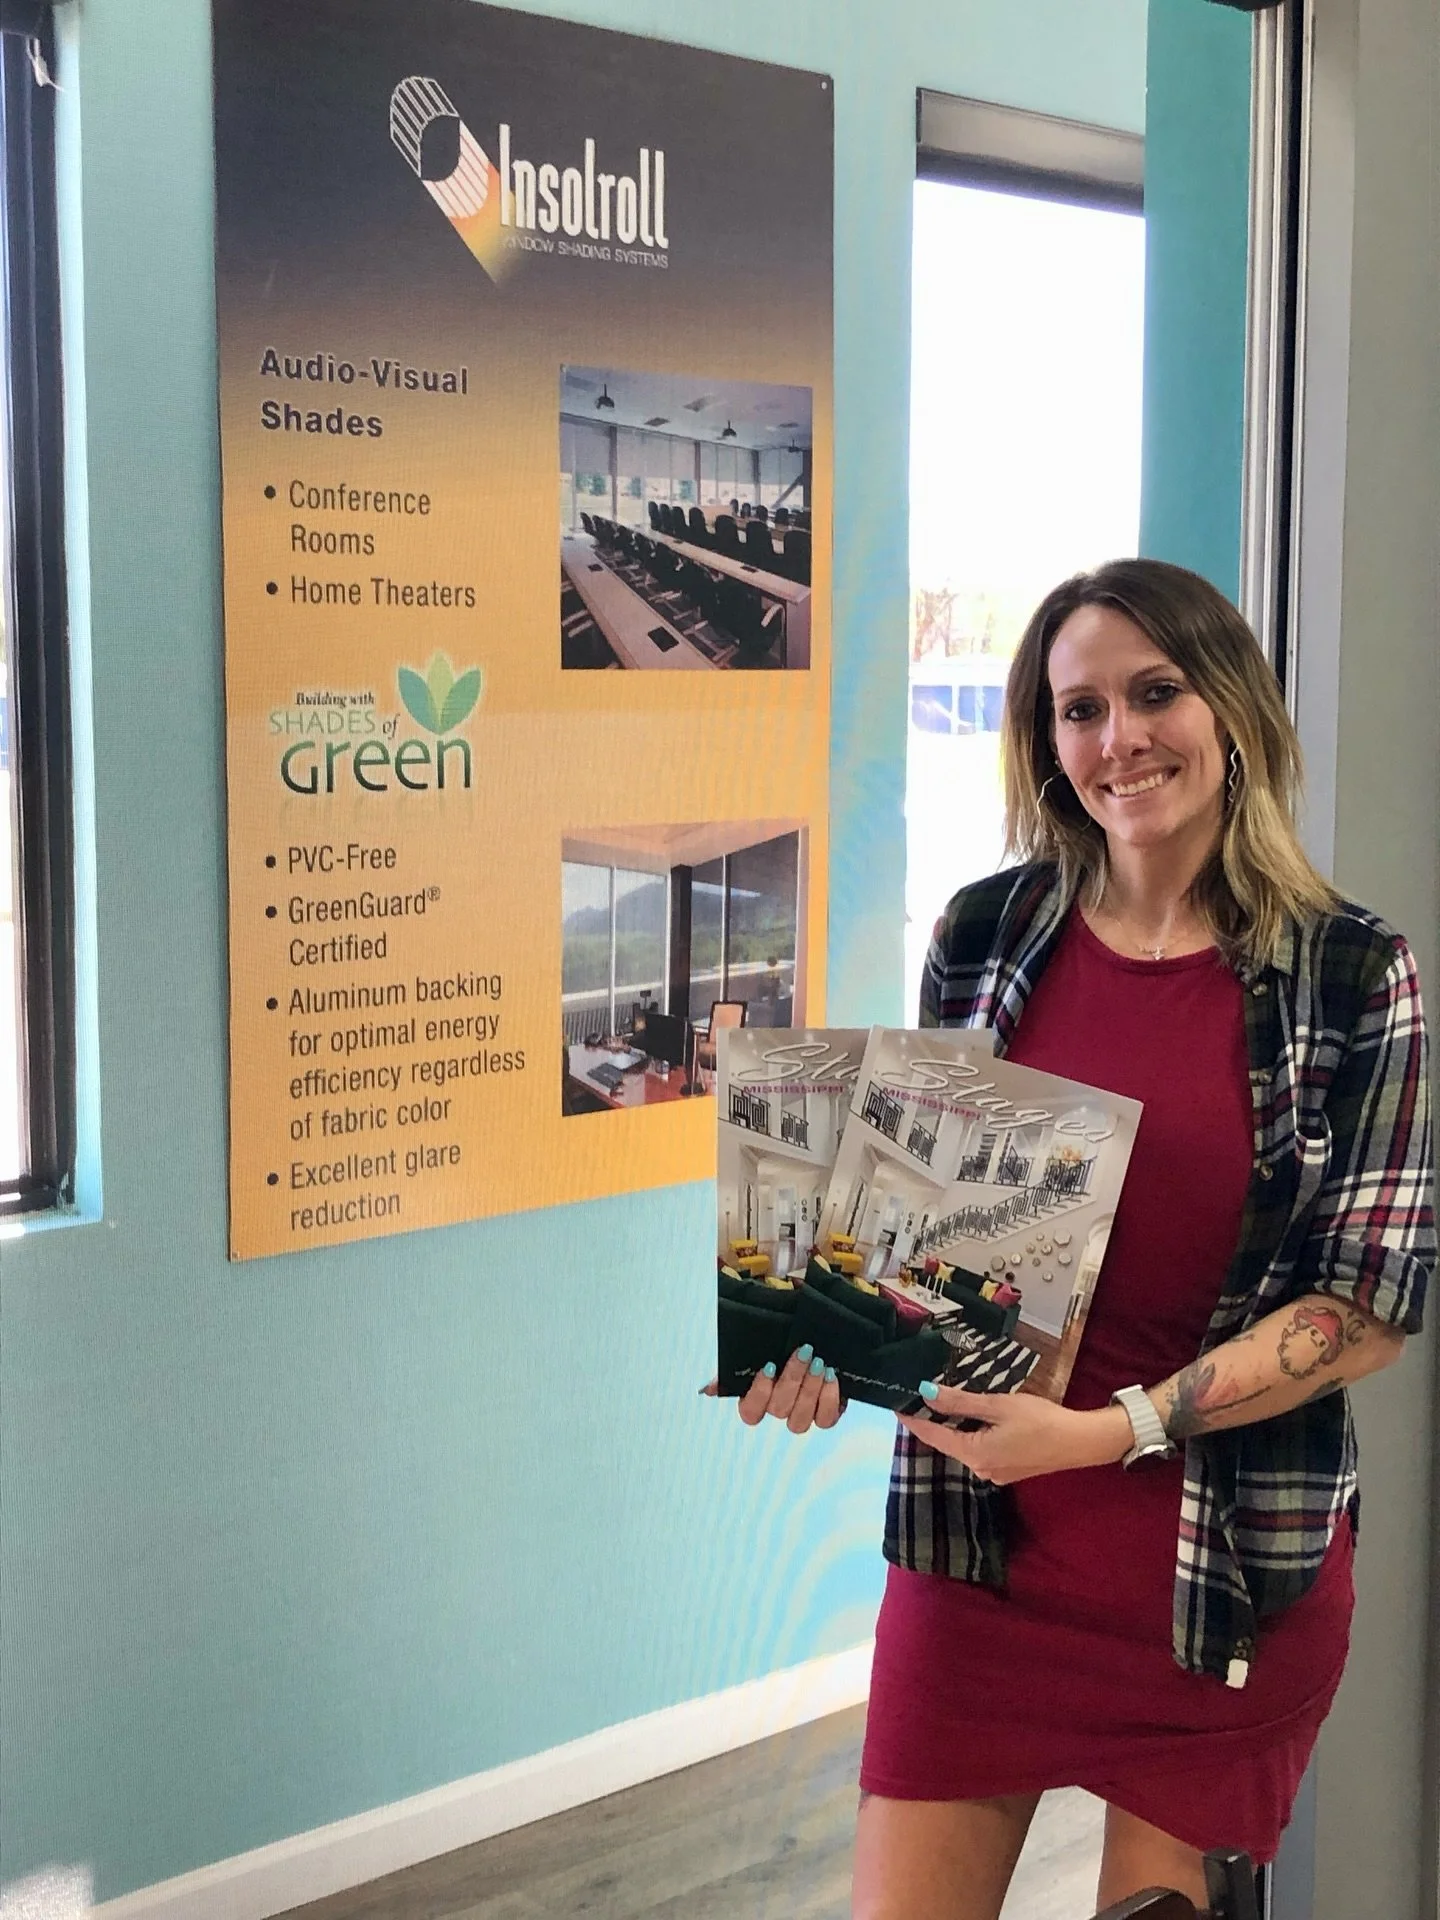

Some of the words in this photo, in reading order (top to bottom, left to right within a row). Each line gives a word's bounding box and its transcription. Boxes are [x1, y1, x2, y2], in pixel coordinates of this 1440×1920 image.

[500, 124, 668, 249] Insolroll
[558, 240, 611, 261] SHADING
[614, 248, 669, 268] SYSTEMS
[260, 348, 468, 395] Audio-Visual
[260, 400, 384, 438] Shades
[289, 479, 432, 515] Conference
[290, 523, 375, 556] Rooms
[290, 574, 362, 605] Home
[370, 576, 476, 608] Theaters
[295, 691, 347, 709] Building
[349, 691, 375, 705] with
[268, 709, 376, 735] SHADES
[382, 713, 400, 740] of
[280, 738, 472, 795] Green
[288, 843, 397, 874] PVC-Free
[289, 931, 387, 966] Certified
[288, 983, 407, 1016] Aluminum
[416, 971, 502, 1002] backing
[288, 1030, 322, 1057] for
[330, 1018, 416, 1056] optimal
[425, 1013, 501, 1042] energy
[289, 1066, 402, 1100] efficiency
[411, 1049, 526, 1087] regardless
[743, 1083, 846, 1095] MISSISSIPPI
[290, 1111, 313, 1141] of
[321, 1103, 388, 1138] fabric
[396, 1096, 452, 1127] color
[878, 1057, 1114, 1144] Stages
[881, 1086, 982, 1121] MISSISSIPPI
[290, 1149, 397, 1190] Excellent
[405, 1143, 462, 1178] glare
[290, 1192, 401, 1231] reduction
